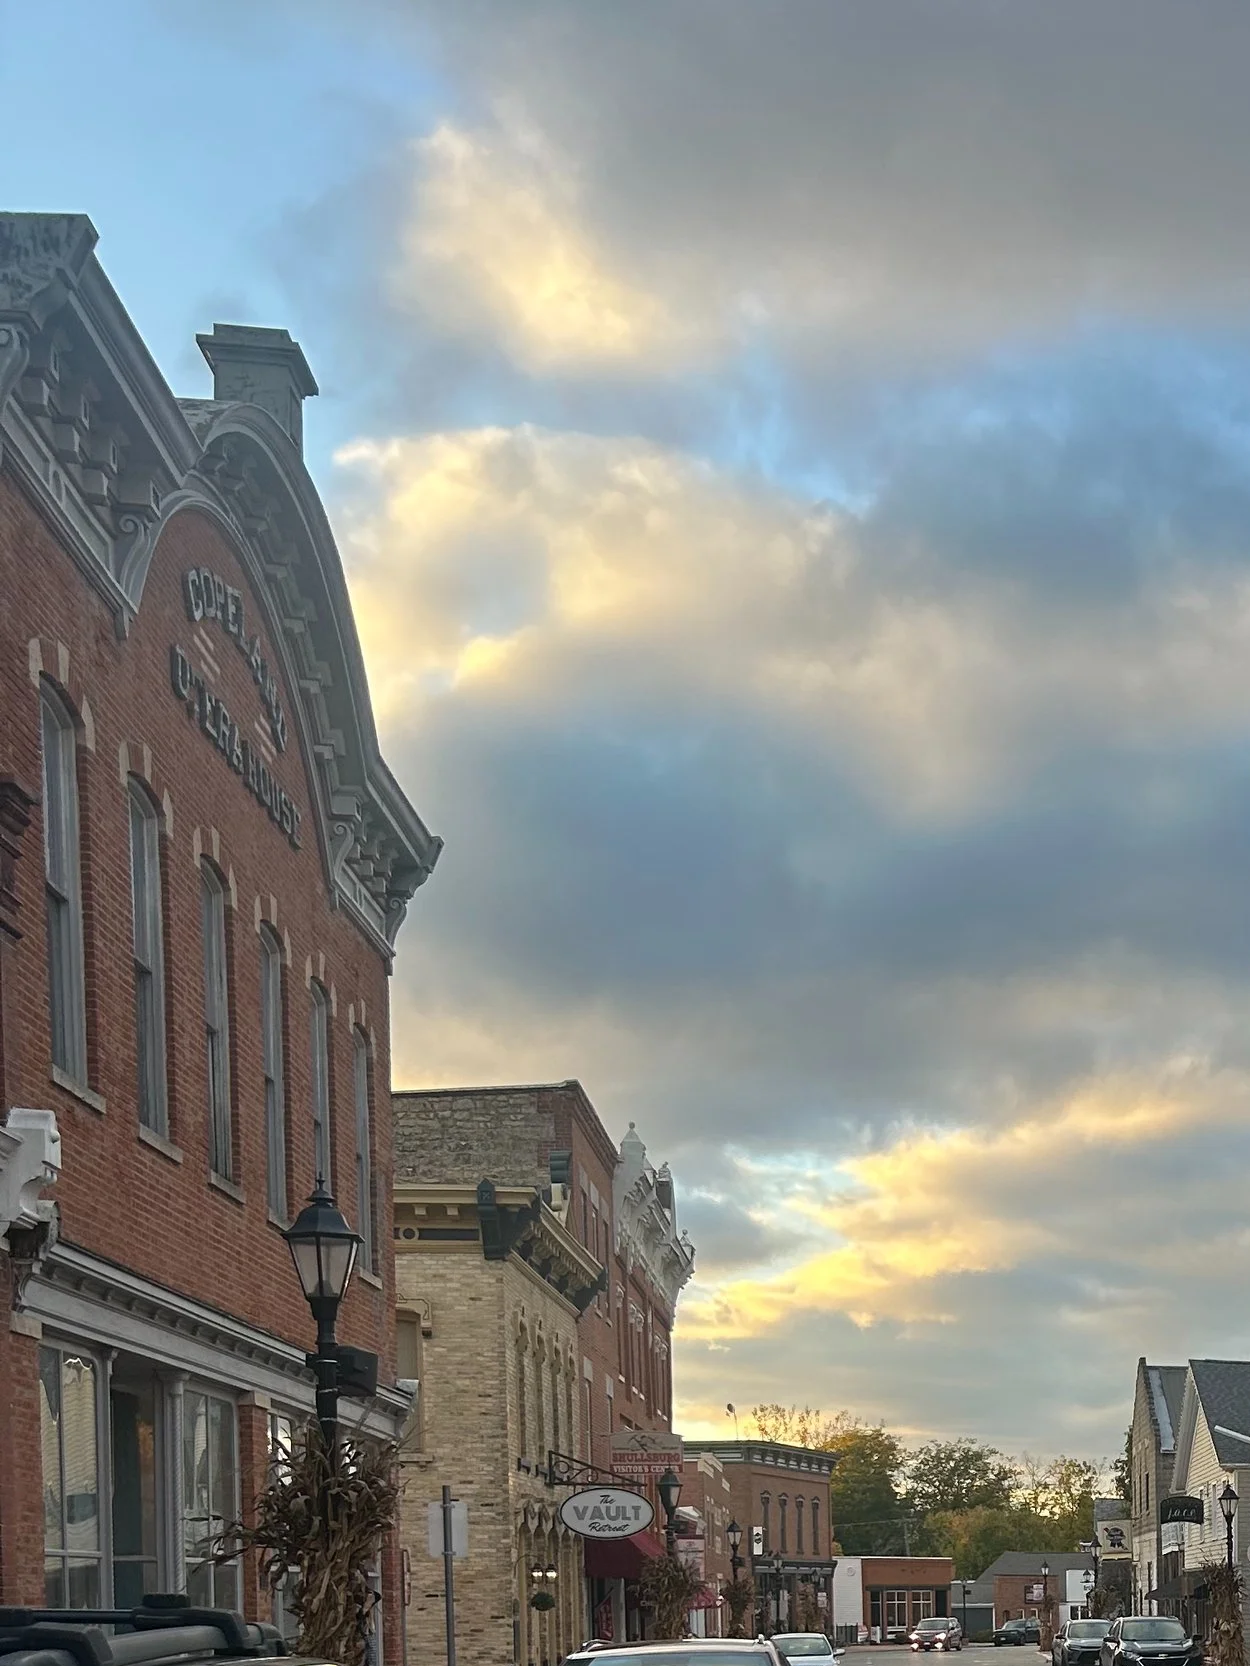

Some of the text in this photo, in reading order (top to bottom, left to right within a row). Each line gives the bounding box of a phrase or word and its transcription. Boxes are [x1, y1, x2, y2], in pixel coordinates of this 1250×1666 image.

[243, 740, 303, 850] HOUSE
[612, 1452, 681, 1464] SHULLSBURG
[613, 1465, 649, 1473] VISITOR'S
[600, 1494, 617, 1505] The
[573, 1505, 642, 1521] VAULT
[588, 1521, 631, 1532] Retreat
